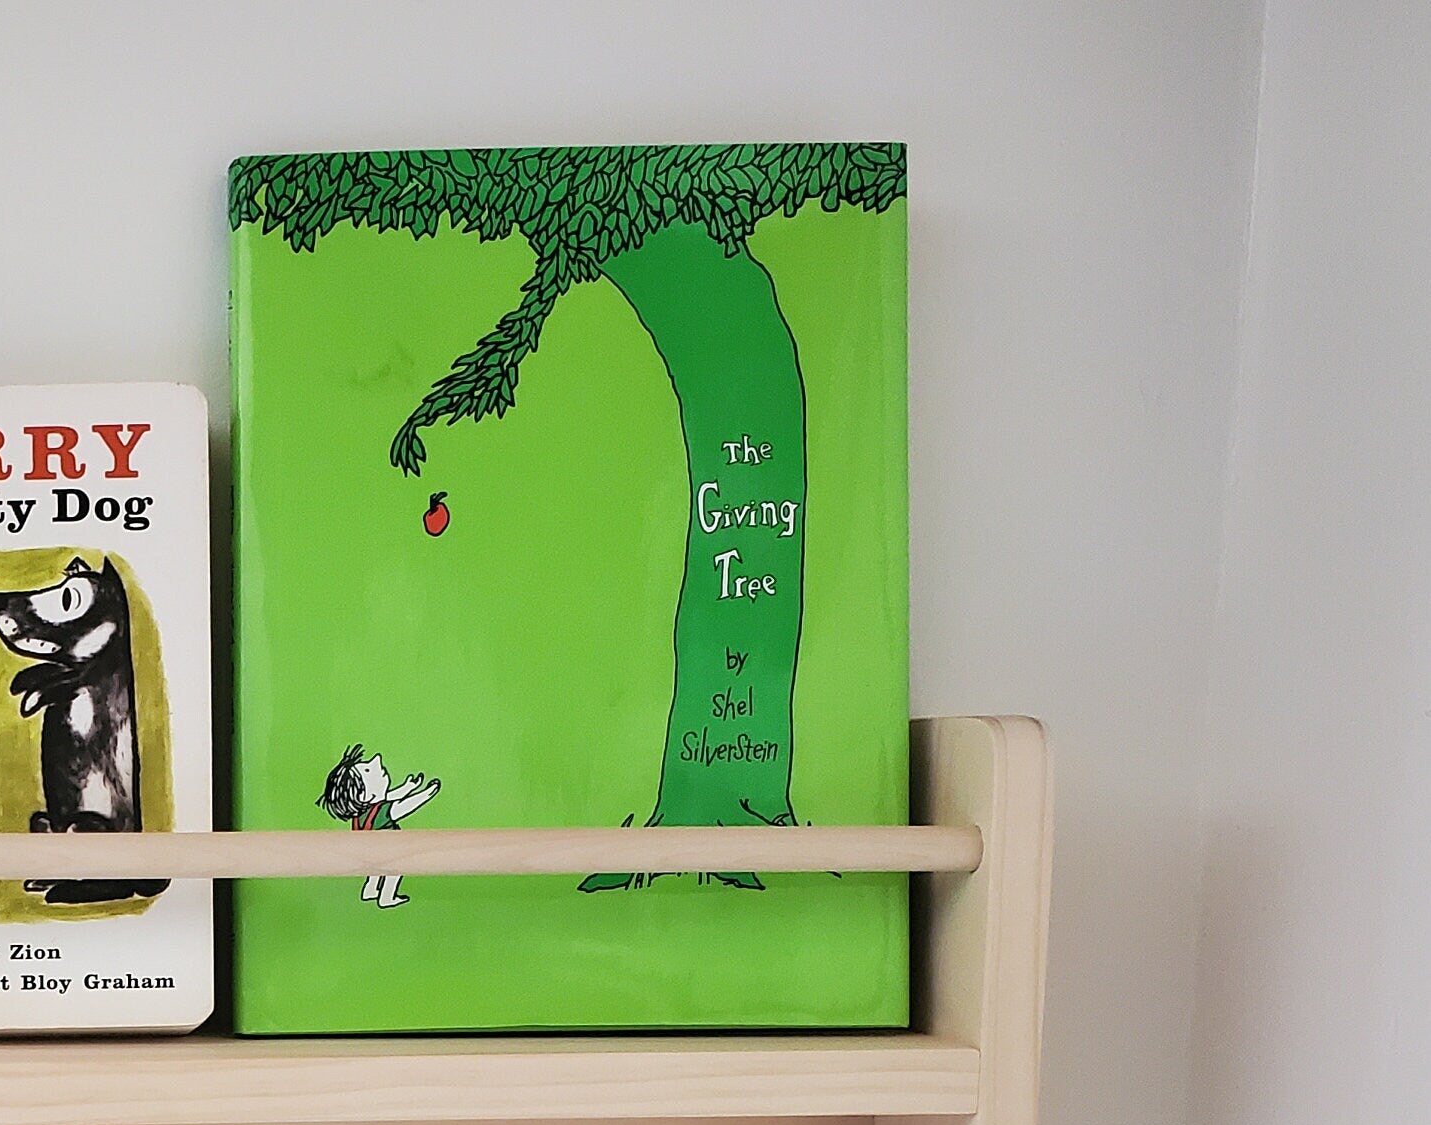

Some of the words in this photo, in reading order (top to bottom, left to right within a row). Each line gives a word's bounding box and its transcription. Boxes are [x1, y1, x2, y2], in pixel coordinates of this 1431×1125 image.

[723, 434, 773, 466] The
[51, 488, 154, 531] Dog
[696, 481, 799, 537] Giving
[714, 548, 776, 601] Tree
[726, 647, 748, 675] by
[712, 686, 753, 721] Shel
[9, 944, 61, 960] Zion
[20, 974, 72, 995] Bloy
[83, 973, 175, 990] Graham
